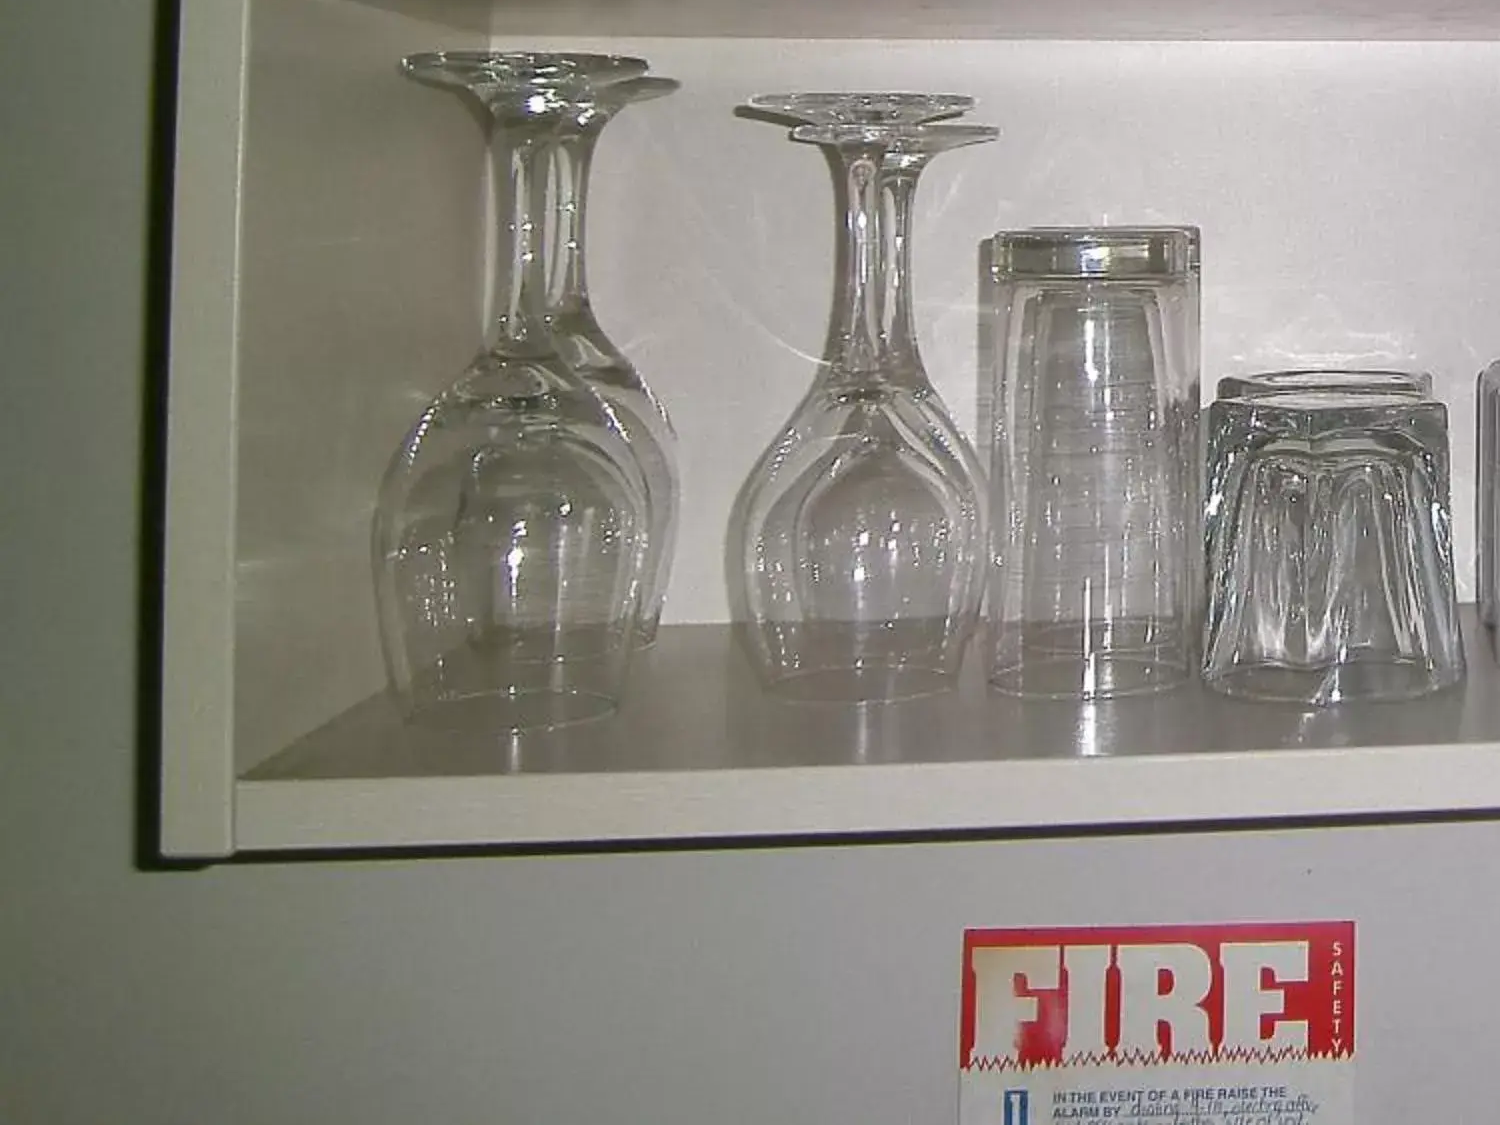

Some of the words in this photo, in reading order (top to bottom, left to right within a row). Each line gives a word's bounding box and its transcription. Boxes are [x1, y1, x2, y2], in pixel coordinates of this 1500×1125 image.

[968, 941, 1309, 1065] FIRE
[1331, 940, 1343, 1052] SAFETY
[1053, 1090, 1068, 1104] IN
[1070, 1089, 1096, 1104] THE
[1100, 1089, 1144, 1103] EVENT
[1147, 1089, 1168, 1103] OF
[1171, 1089, 1181, 1101] A
[1183, 1088, 1215, 1101] FIRE
[1217, 1087, 1256, 1100] RAISE
[1261, 1086, 1287, 1099] THE
[1053, 1105, 1100, 1119] ALARM
[1103, 1105, 1121, 1118] BY
